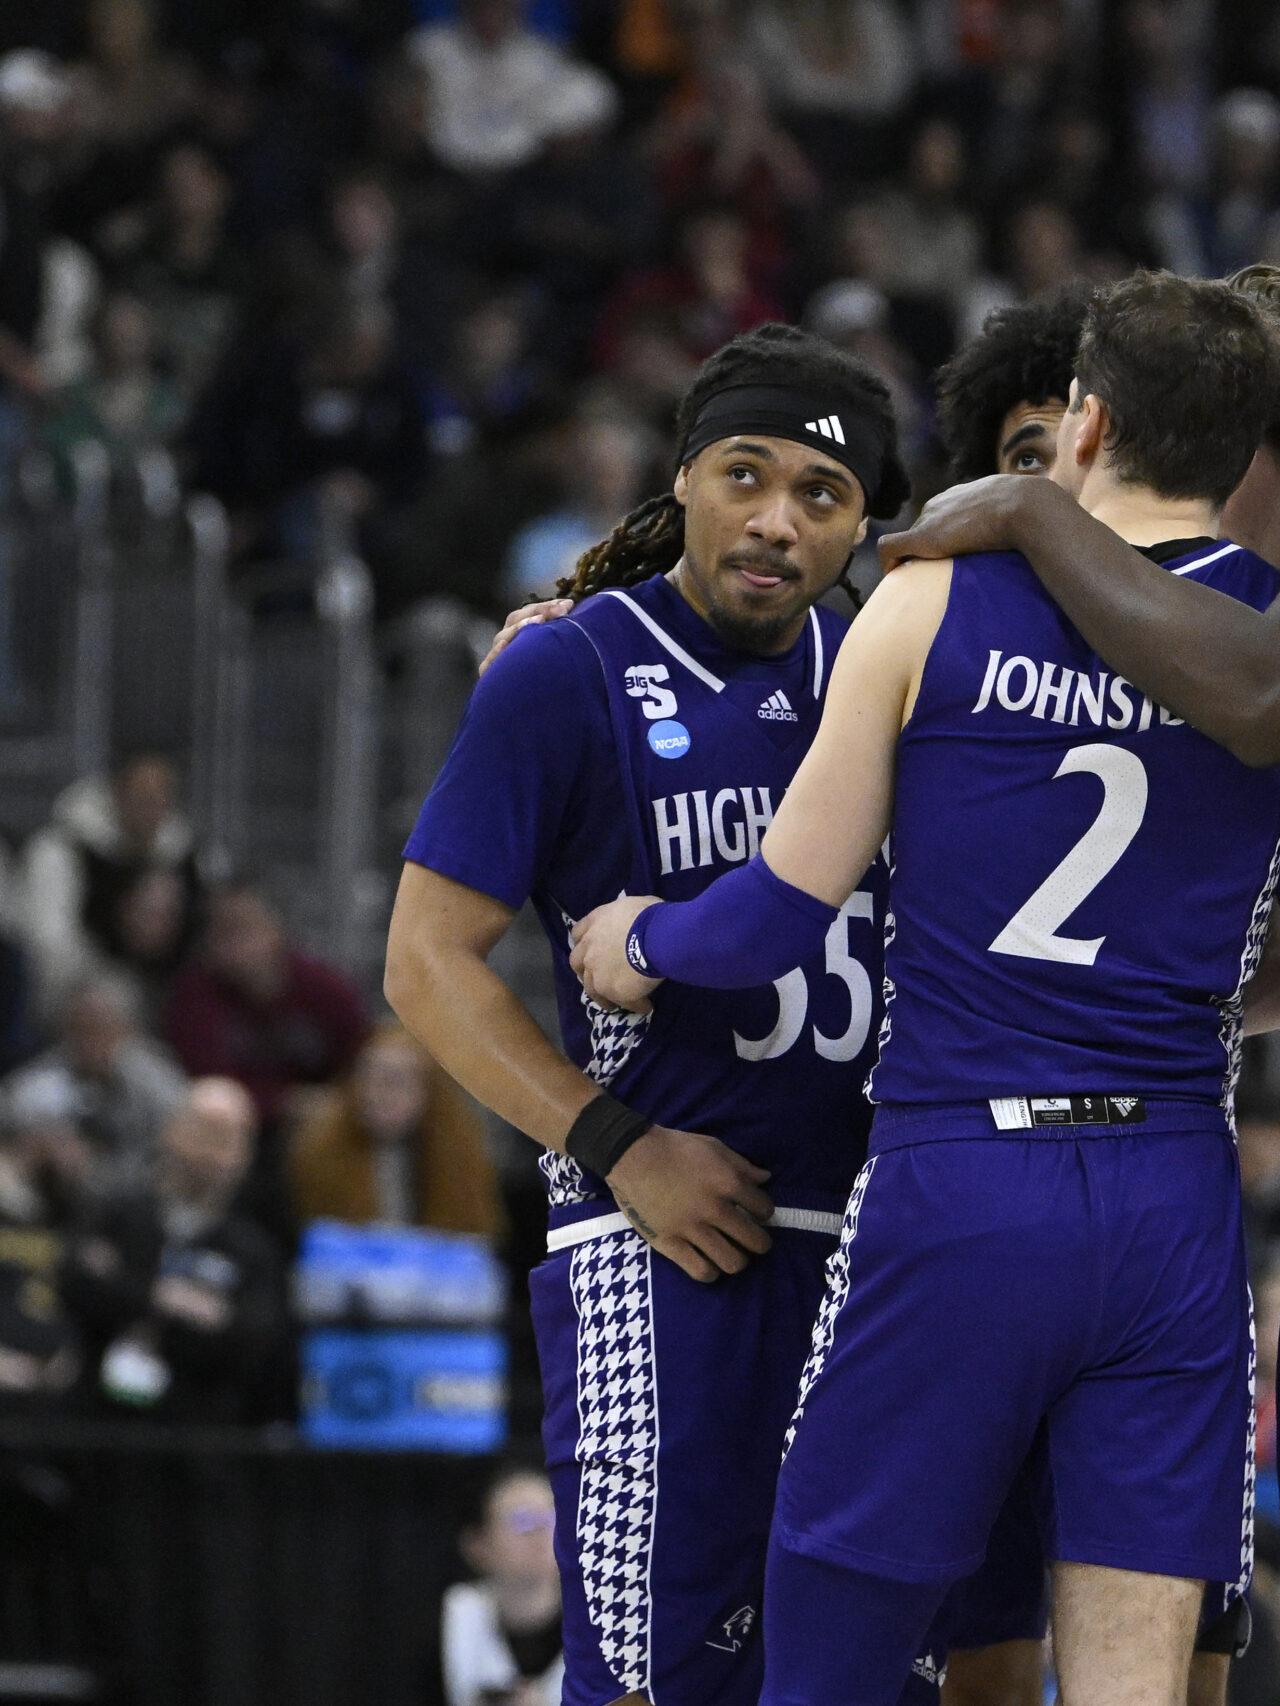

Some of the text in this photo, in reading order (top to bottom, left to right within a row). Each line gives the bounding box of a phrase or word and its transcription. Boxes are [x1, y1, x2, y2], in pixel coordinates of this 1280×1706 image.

[624, 674, 649, 689] BIG
[757, 708, 799, 722] adidas
[654, 735, 689, 750] NCAA
[652, 786, 774, 876] HIGH
[988, 743, 1149, 966] 2
